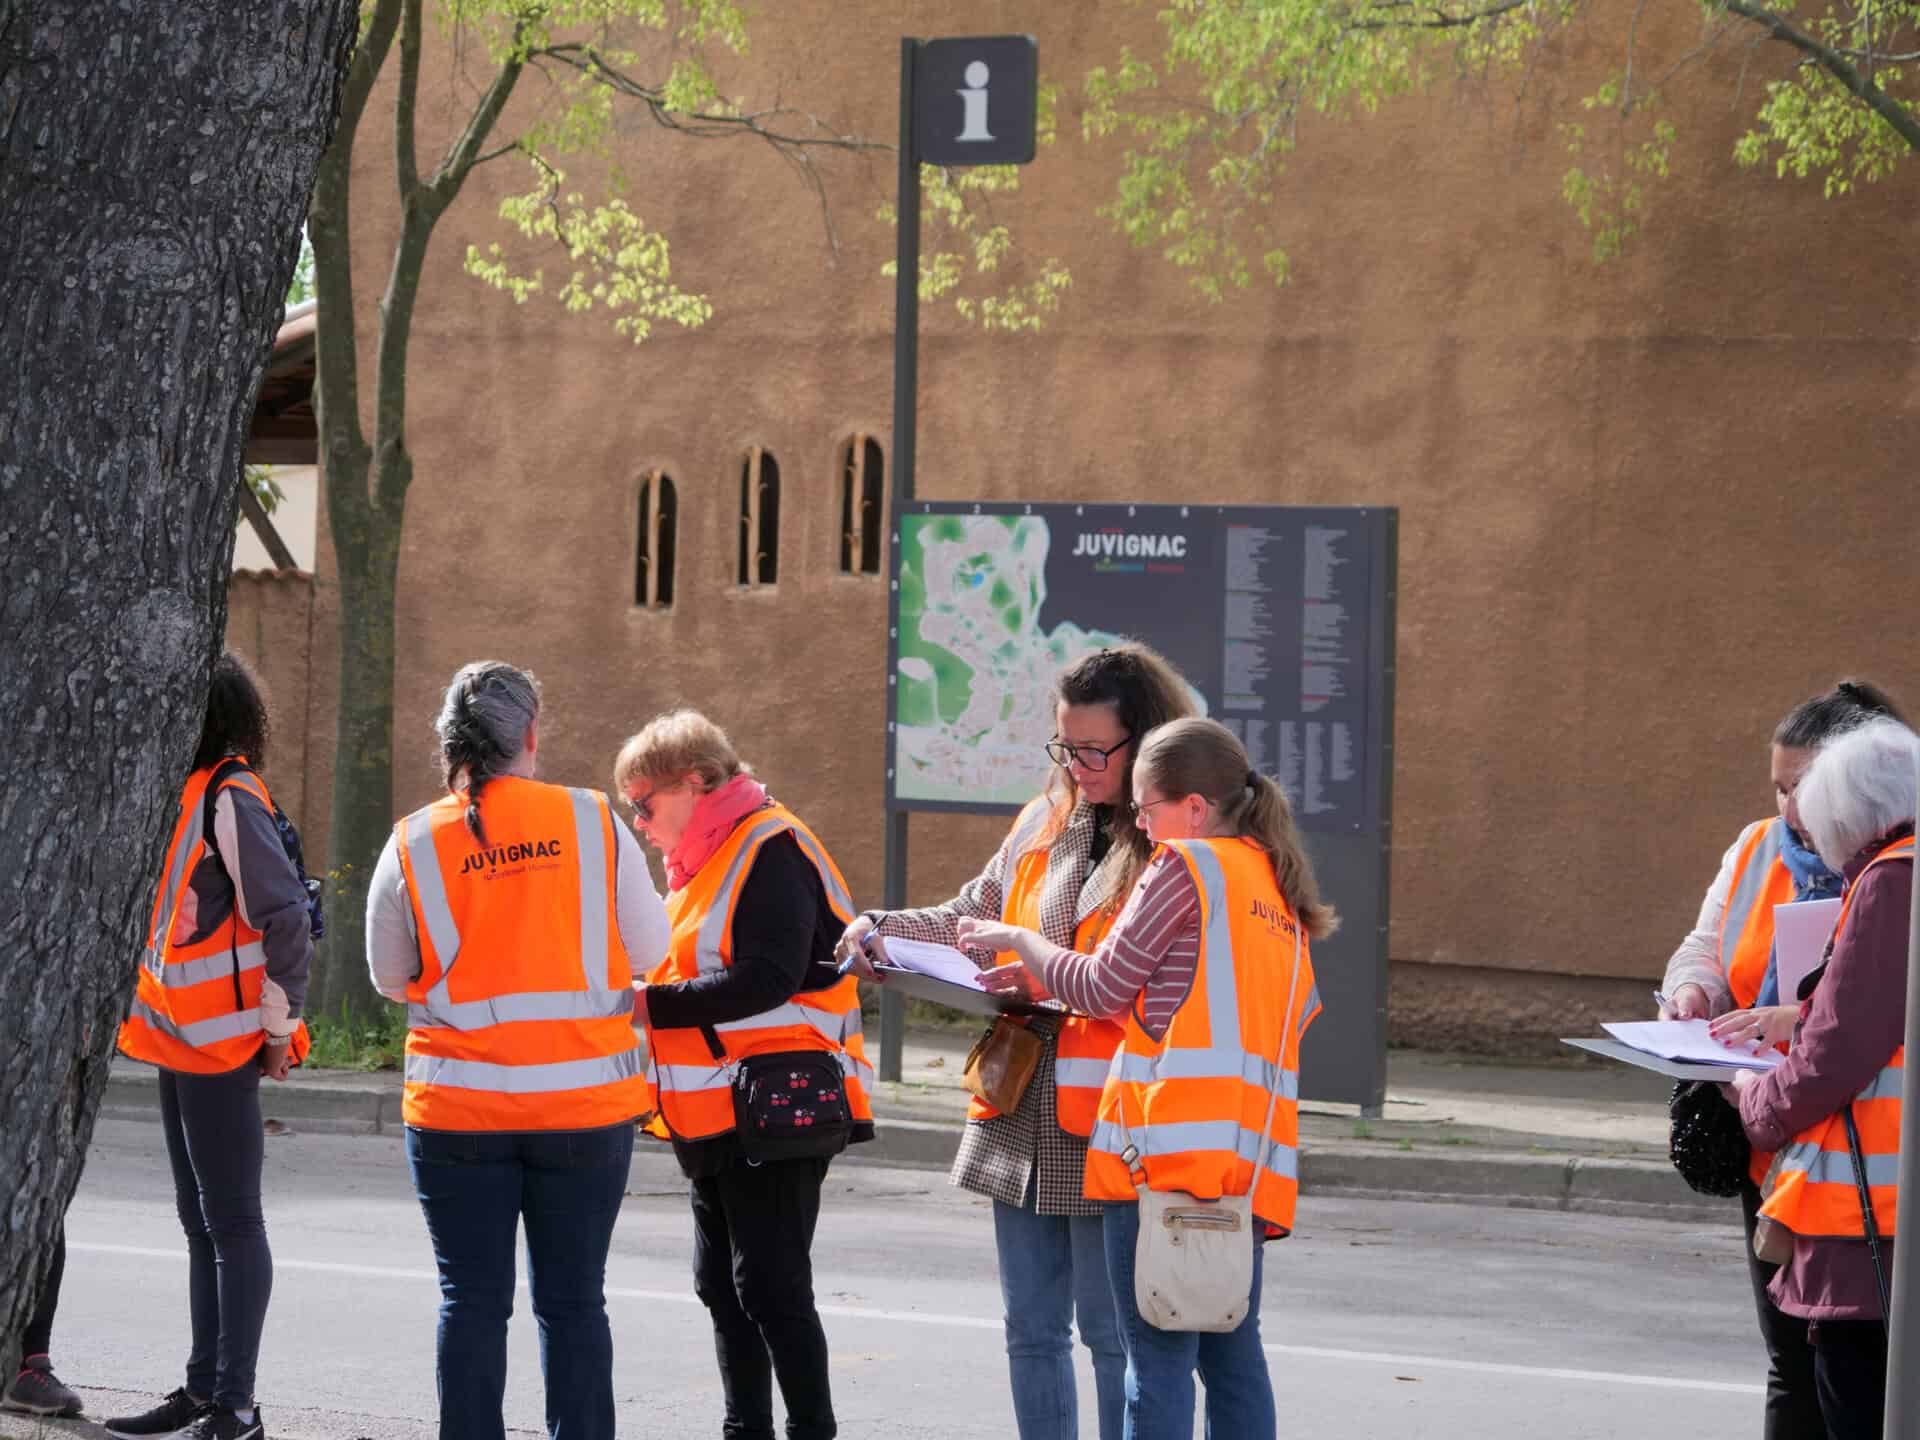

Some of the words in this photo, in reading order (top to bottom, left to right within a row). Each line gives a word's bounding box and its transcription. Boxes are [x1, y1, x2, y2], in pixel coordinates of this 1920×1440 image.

[955, 60, 997, 142] i
[1073, 533, 1187, 557] JUVIGNAC
[461, 840, 561, 873] JUVIGNAC
